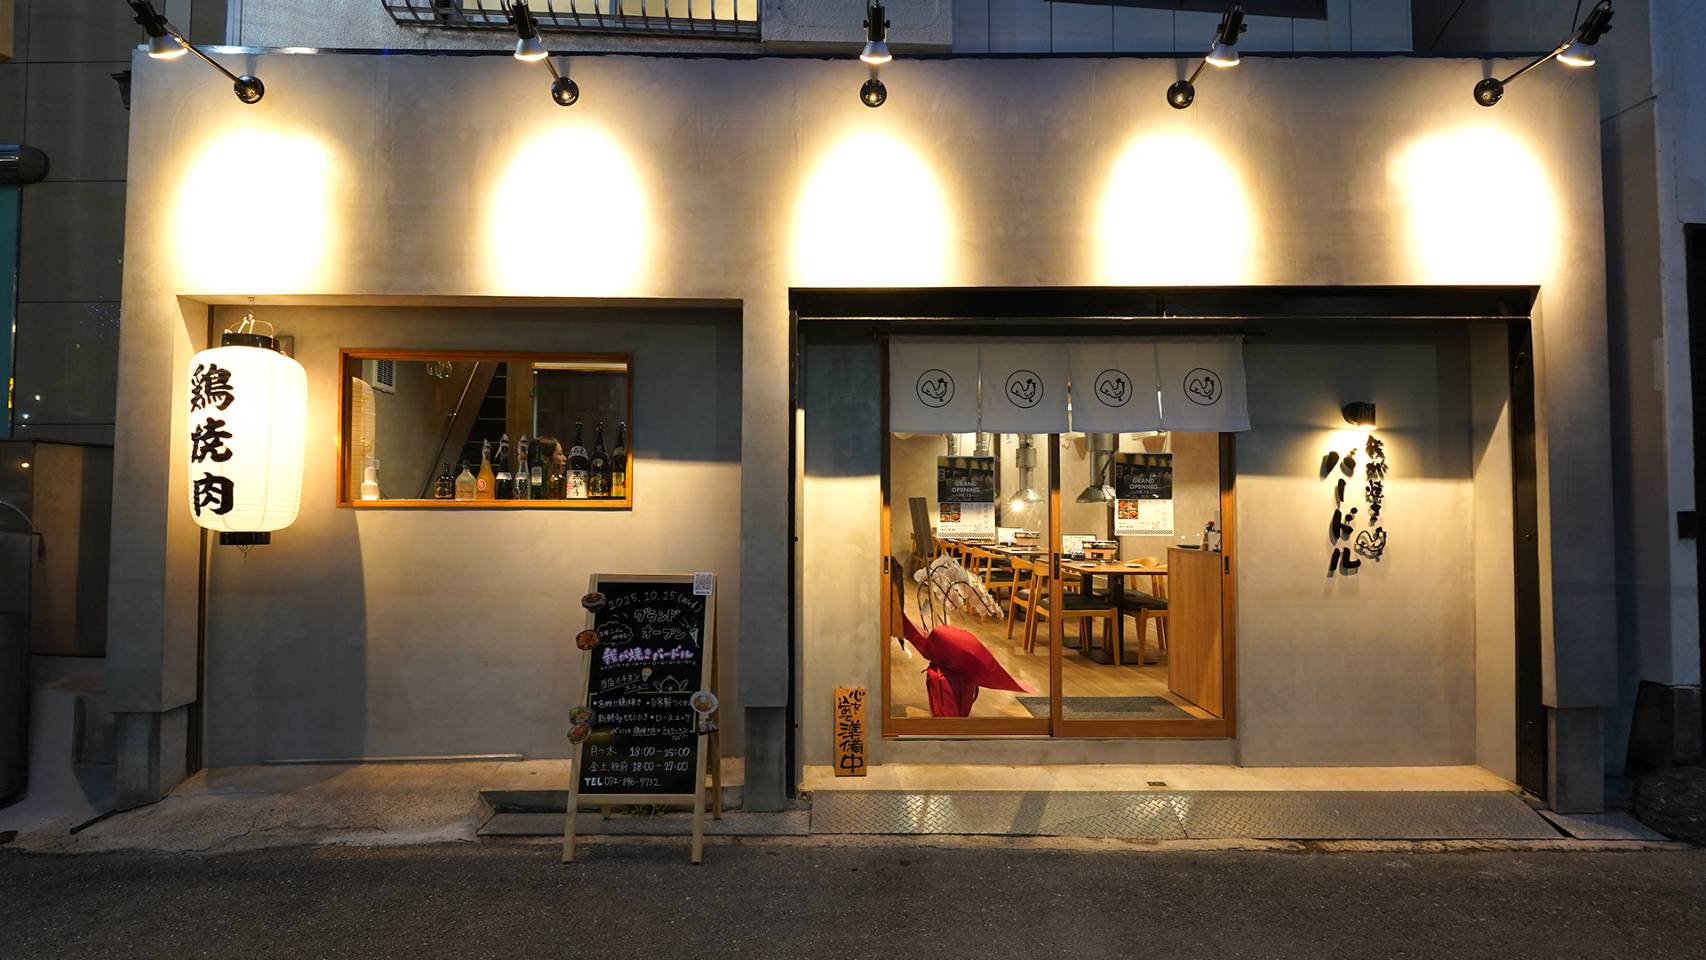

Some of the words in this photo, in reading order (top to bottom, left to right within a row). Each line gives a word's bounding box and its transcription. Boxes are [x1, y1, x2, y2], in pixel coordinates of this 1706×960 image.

[190, 362, 235, 518] 鶏焼肉
[1325, 448, 1362, 571] バードル
[634, 607, 681, 622] グランド
[641, 624, 686, 640] オープン
[838, 720, 864, 773] 準備中
[584, 777, 603, 786] TEL
